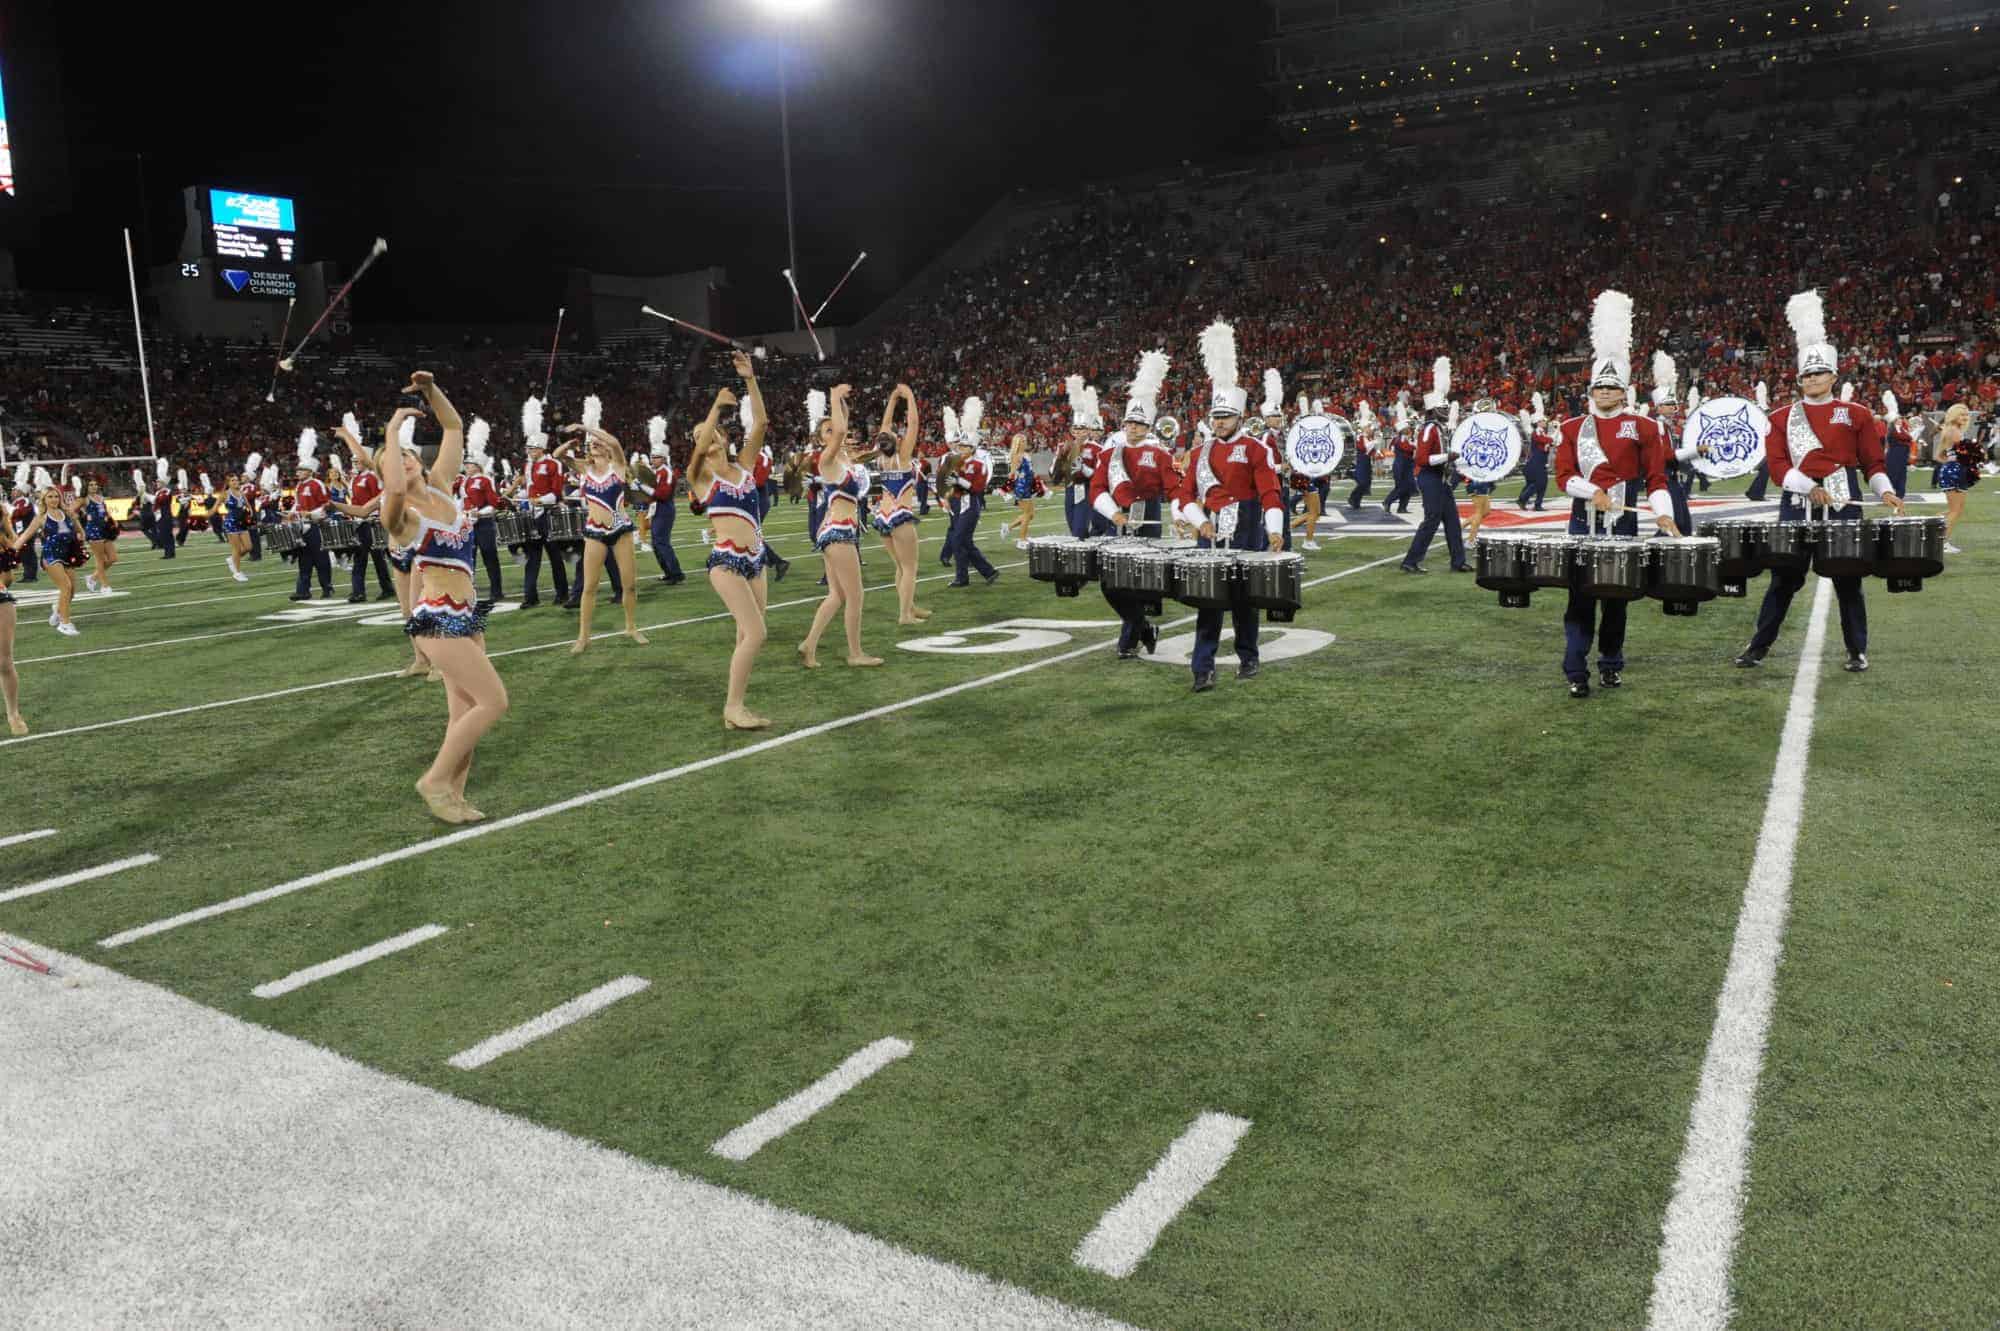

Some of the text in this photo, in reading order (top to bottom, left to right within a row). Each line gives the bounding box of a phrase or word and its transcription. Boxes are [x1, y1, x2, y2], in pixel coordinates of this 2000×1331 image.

[182, 263, 199, 277] 25
[253, 271, 291, 281] DESERT
[249, 279, 296, 289] DIAMOND
[251, 286, 295, 296] CASINOS
[1829, 407, 1852, 425] A
[1616, 420, 1640, 440] A
[1138, 451, 1157, 468] A
[1227, 445, 1249, 463] A
[896, 618, 1337, 665] 50
